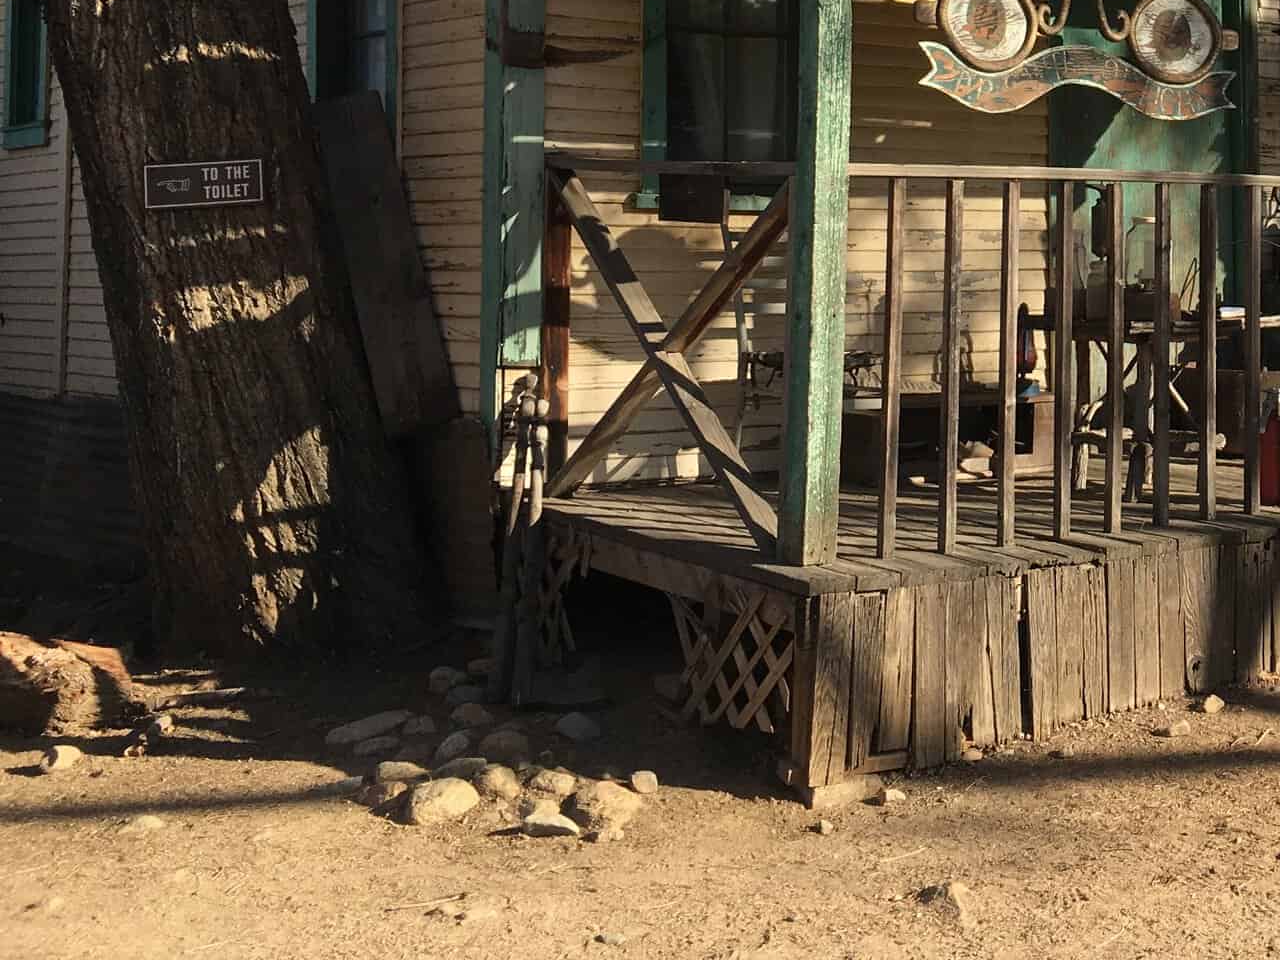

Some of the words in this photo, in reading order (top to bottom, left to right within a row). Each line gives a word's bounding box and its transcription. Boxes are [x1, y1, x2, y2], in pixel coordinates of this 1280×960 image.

[201, 167, 218, 181] TO
[224, 165, 250, 179] THE
[203, 183, 249, 199] TOILET
